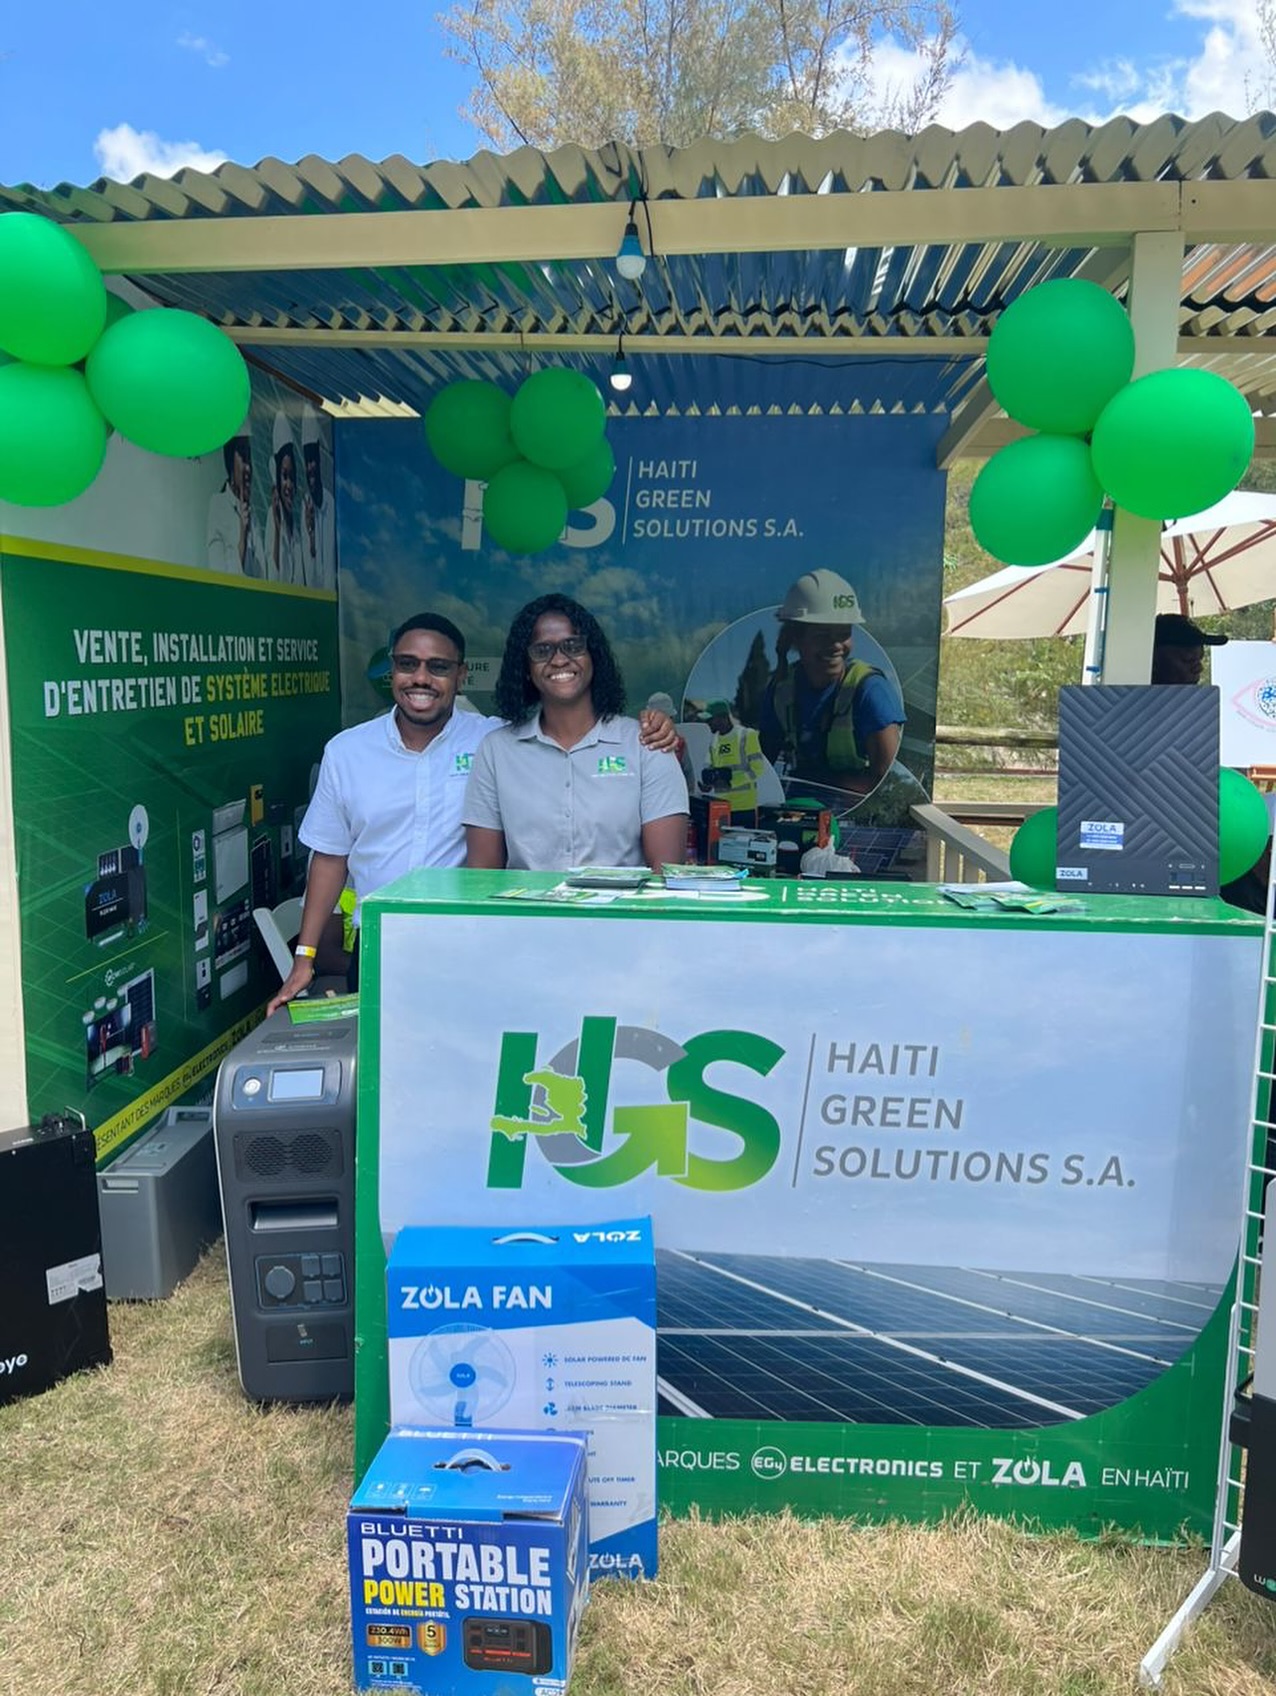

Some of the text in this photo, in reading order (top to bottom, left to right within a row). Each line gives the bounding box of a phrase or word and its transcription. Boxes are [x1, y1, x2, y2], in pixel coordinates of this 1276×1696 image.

[638, 460, 697, 479] HAITI
[635, 489, 712, 508] GREEN
[632, 519, 804, 539] SOLUTIONS S.A.
[73, 629, 319, 666] VENTE, INSTALLATION ET SERVICE
[44, 674, 177, 718] D'ENTRETIEN
[181, 675, 202, 704] DE
[206, 666, 269, 702] SYSTÈME
[184, 709, 265, 745] ET SOLAIRE
[1088, 823, 1117, 832] ZOLA
[826, 1041, 939, 1077] HAITI
[136, 1103, 150, 1120] DES
[820, 1094, 964, 1130] GREEN
[813, 1146, 1136, 1187] SOLUTIONS S.A.
[573, 1230, 641, 1243] ZOLA
[401, 1284, 553, 1310] ZOLA FAN
[790, 1455, 943, 1478] ELECTRONICS
[954, 1461, 981, 1479] ET
[991, 1456, 1086, 1487] ZOLA
[1102, 1468, 1130, 1486] EN
[1135, 1467, 1189, 1488] HAÏTI
[361, 1522, 463, 1539] BLUETTI
[361, 1539, 551, 1587] PORTABLE
[589, 1553, 643, 1569] ZOLA
[363, 1579, 552, 1616] POWER STATION
[427, 1625, 437, 1638] 5
